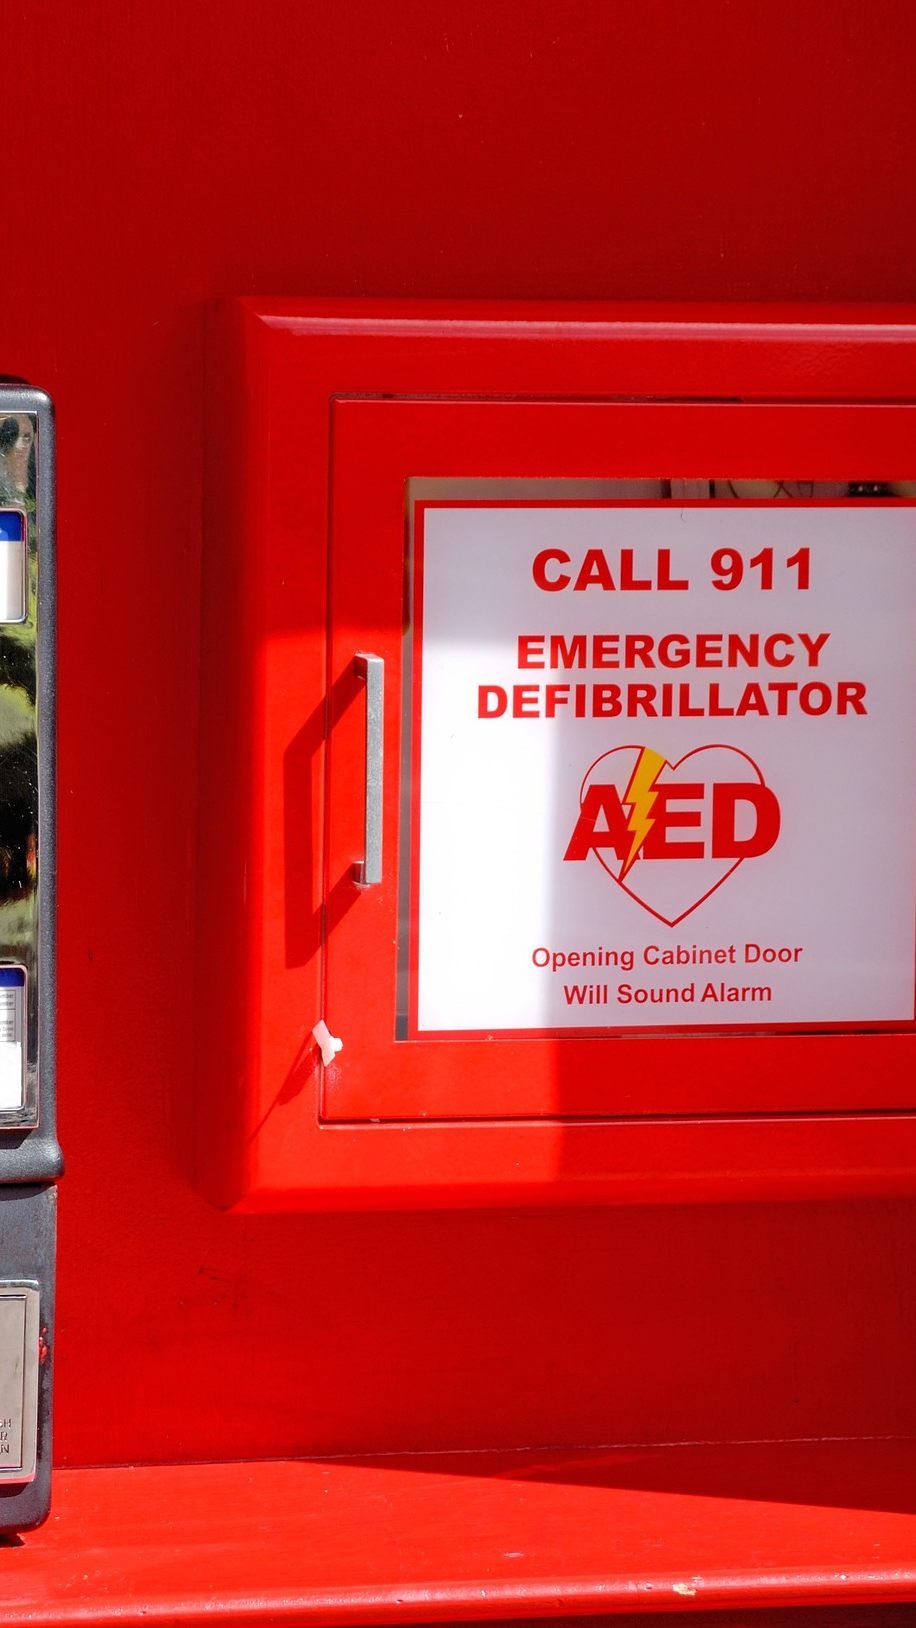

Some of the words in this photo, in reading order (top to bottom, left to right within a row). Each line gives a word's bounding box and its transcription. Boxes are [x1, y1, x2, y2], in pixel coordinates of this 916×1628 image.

[532, 547, 690, 592] CALL
[709, 546, 811, 592] 911
[517, 633, 831, 671] EMERGENCY
[478, 680, 868, 719] DEFIBRILLATOR
[563, 782, 781, 861] AED
[532, 947, 635, 972] Opening
[643, 944, 736, 966] Cabinet
[744, 943, 803, 964] Door
[563, 984, 608, 1005] Will
[616, 982, 695, 1005] Sound
[700, 982, 772, 1003] Alarm
